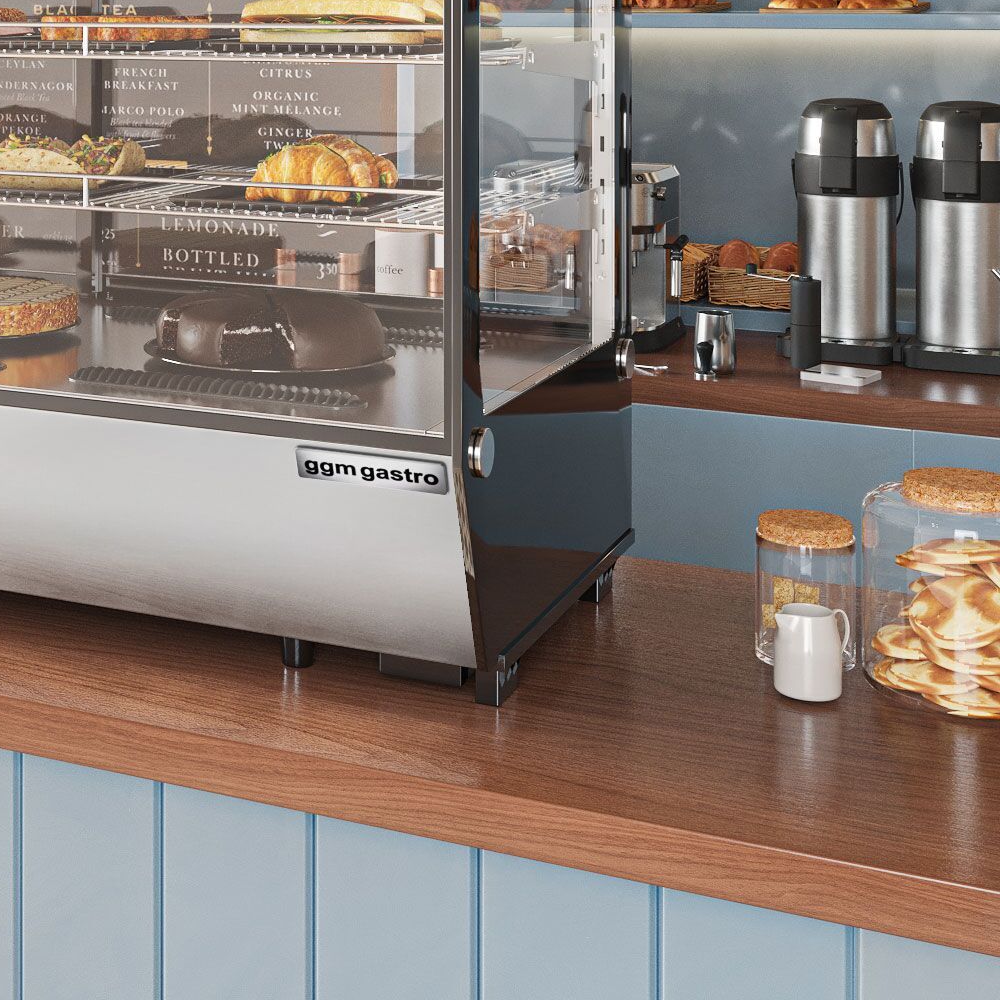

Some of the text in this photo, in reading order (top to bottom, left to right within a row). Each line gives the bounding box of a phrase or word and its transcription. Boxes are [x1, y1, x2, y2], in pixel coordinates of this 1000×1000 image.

[102, 4, 138, 17] TEA
[114, 67, 167, 77] FRENCH
[259, 67, 312, 79] CITRUS
[104, 80, 179, 91] BREAKFAST
[253, 91, 319, 102] ORGANIC
[149, 106, 185, 117] POLO
[232, 103, 268, 114] MINT
[2, 126, 42, 136] PEKOE
[257, 127, 313, 138] GINGER
[161, 216, 280, 238] LEMONADE
[163, 248, 260, 268] BOTTLED
[304, 459, 439, 486] ggm gastro
